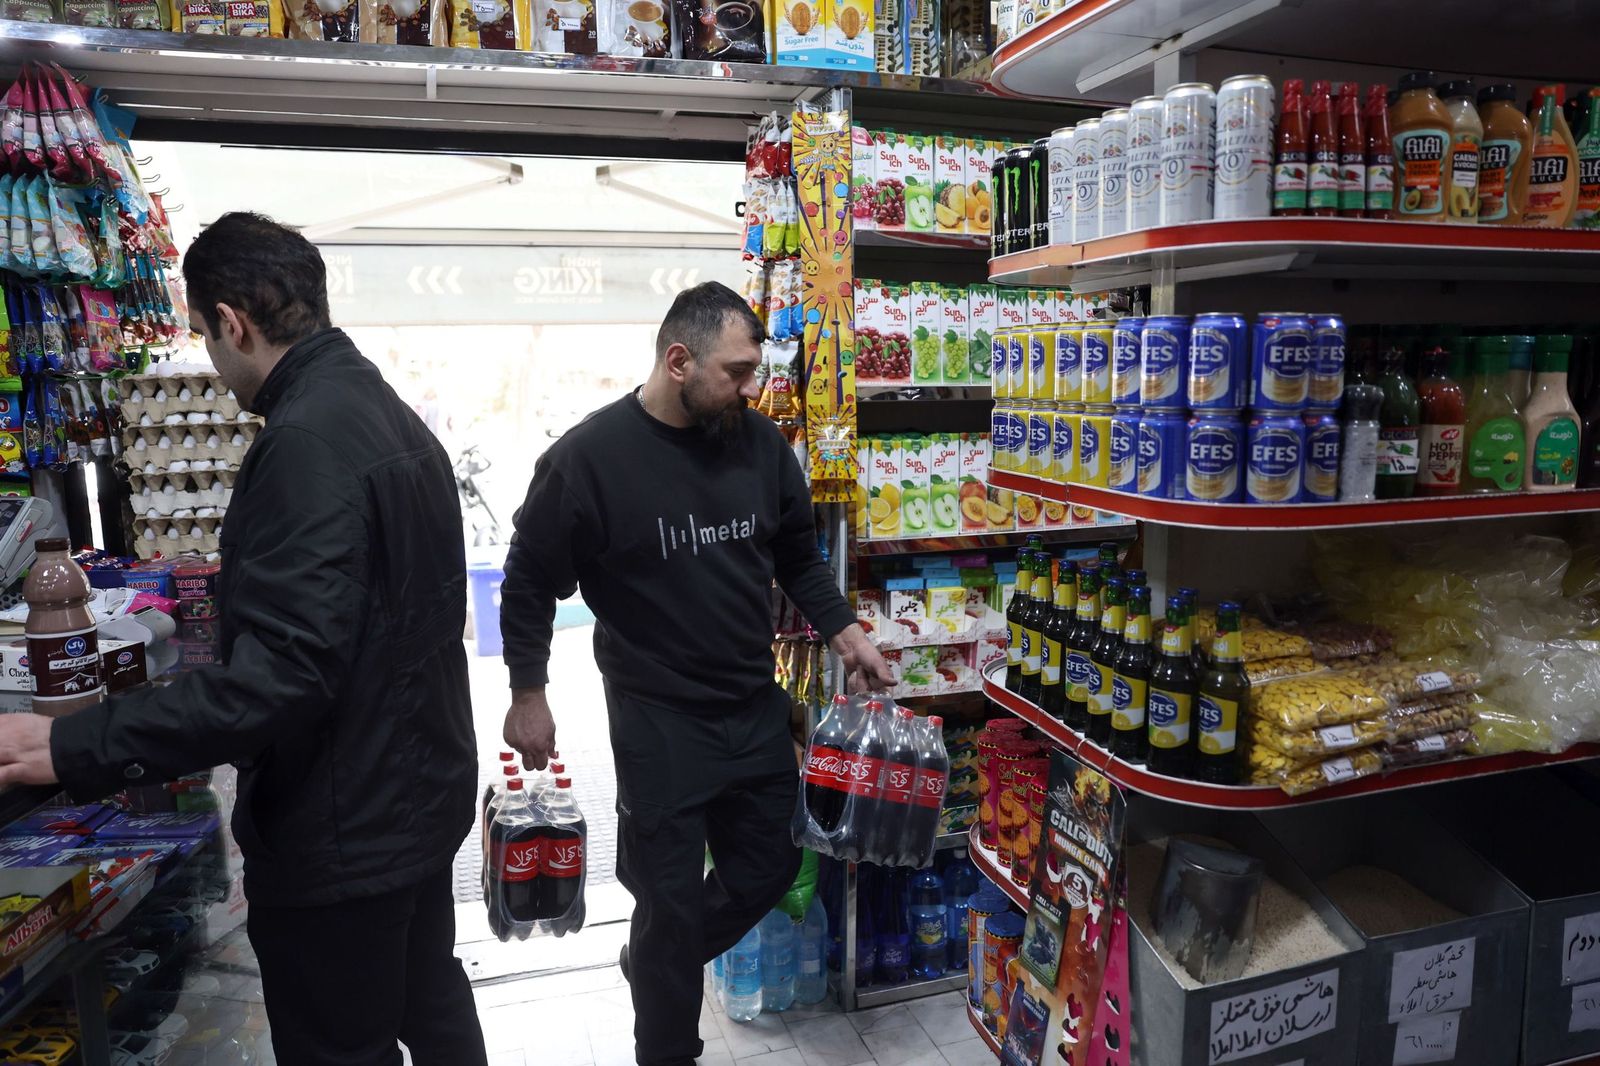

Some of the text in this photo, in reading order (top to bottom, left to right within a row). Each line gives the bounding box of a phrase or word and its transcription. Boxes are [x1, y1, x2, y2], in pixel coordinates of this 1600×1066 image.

[65, 1, 107, 9] Cappuccino
[188, 6, 212, 14] BIKA
[230, 2, 255, 10] TORA
[1027, 12, 1034, 24] 0
[785, 36, 819, 48] Sugar Free
[848, 43, 865, 51] بدون
[1406, 138, 1440, 154] filfil
[880, 151, 897, 165] Sun
[890, 158, 902, 168] ich
[908, 154, 924, 168] Sun
[939, 156, 956, 170] Sun
[917, 162, 930, 171] ich
[948, 163, 961, 172] ich
[969, 158, 985, 172] Sun
[978, 165, 991, 173] ich
[1531, 159, 1564, 175] ilfil
[863, 297, 879, 306] سن
[922, 299, 938, 308] سن
[979, 300, 994, 309] سن
[884, 306, 902, 320] Sun
[894, 313, 907, 324] ich
[944, 308, 961, 321] Sun
[1002, 309, 1018, 319] Sun
[1011, 314, 1023, 323] ich
[1032, 309, 1047, 319] Sun
[1040, 314, 1052, 323] ich
[1059, 309, 1074, 319] Sun
[953, 315, 966, 326] ich
[1059, 347, 1076, 361] ES
[1085, 346, 1104, 361] ES
[1116, 345, 1136, 361] ES
[1269, 346, 1311, 363] EFES
[1054, 431, 1068, 446] ES
[1082, 435, 1094, 450] ES
[1139, 441, 1156, 457] ES
[1190, 443, 1234, 461] EFES
[1252, 445, 1297, 462] EFES
[1312, 442, 1339, 458] EFE
[1430, 443, 1453, 452] HOT
[940, 450, 956, 459] سن
[970, 449, 985, 459] سن
[876, 458, 893, 470] Sun
[885, 465, 898, 475] ich
[906, 458, 922, 470] Sun
[915, 465, 927, 474] ich
[700, 514, 756, 545] metal
[127, 581, 159, 590] HARIBO
[176, 579, 207, 588] HARIBO
[1067, 660, 1090, 675] EFES
[1113, 683, 1130, 700] FES
[1201, 706, 1219, 722] FES
[1050, 809, 1080, 842] CALL
[1086, 834, 1113, 871] DUTY
[1072, 874, 1083, 893] 5
[4, 907, 54, 956] Albeni
[1429, 970, 1457, 990] هاشمی
[1215, 977, 1334, 1035] هاشمی فوق ممتاز
[1265, 1002, 1332, 1045] ارسلان
